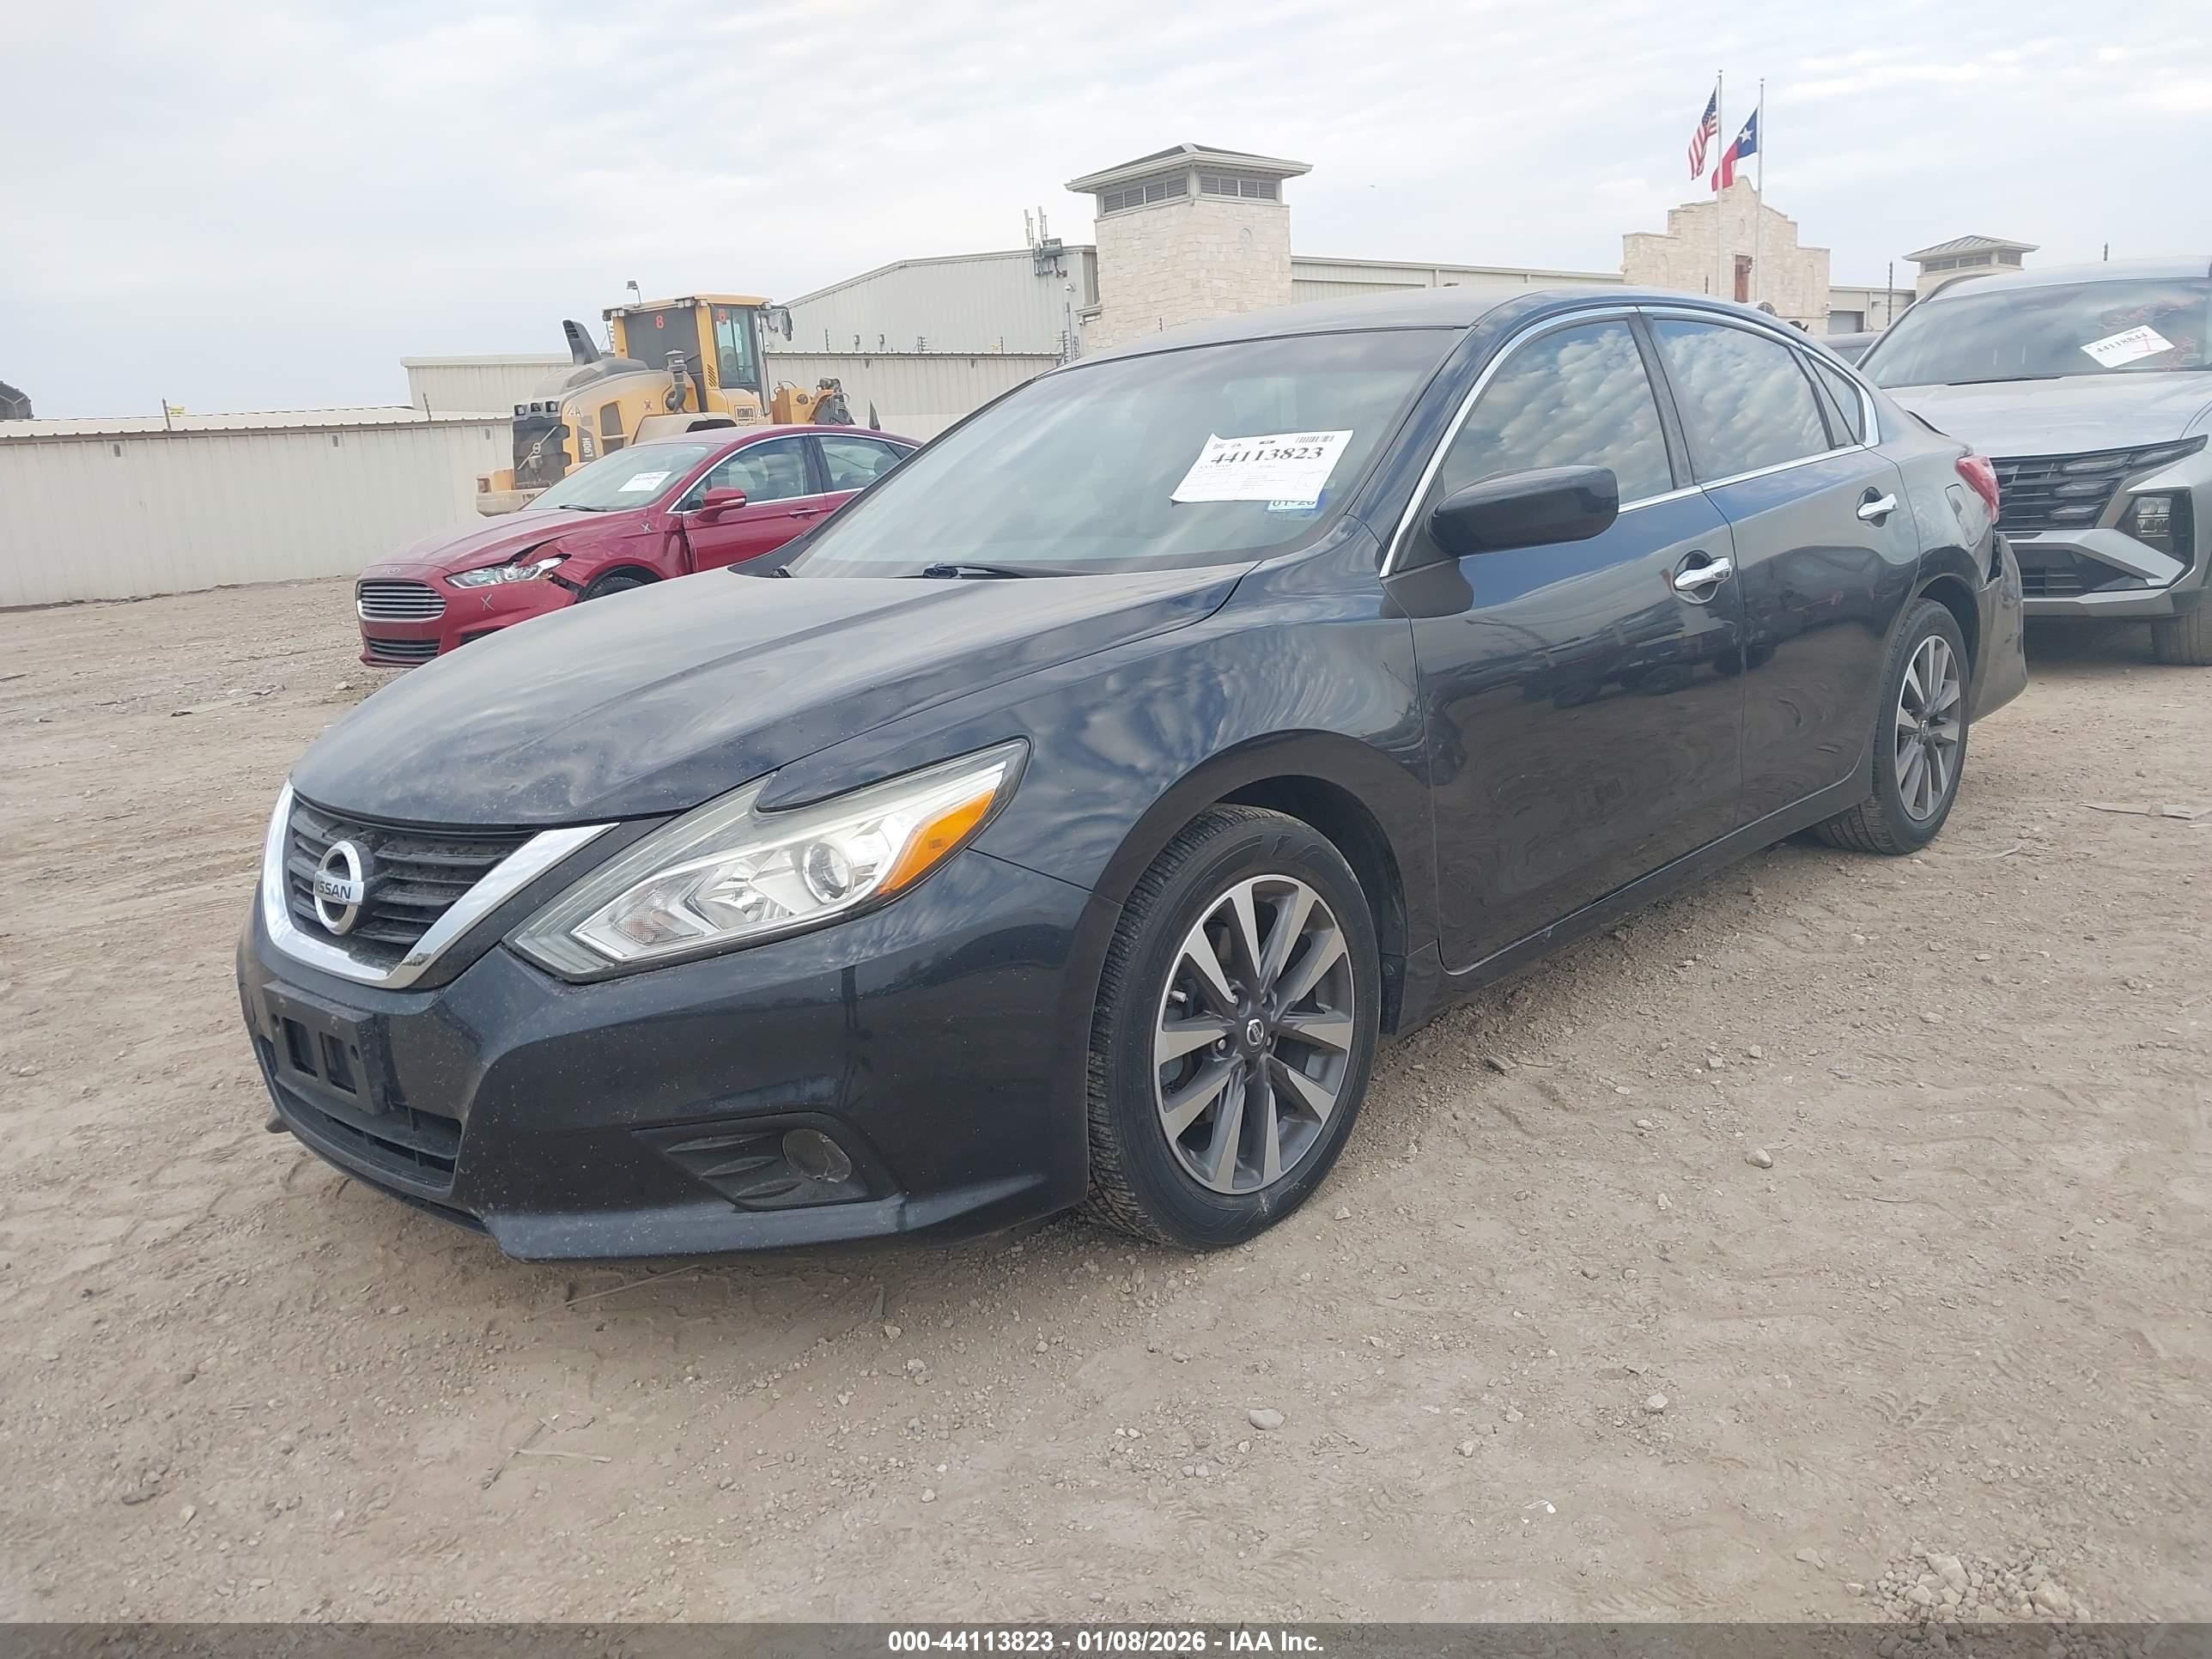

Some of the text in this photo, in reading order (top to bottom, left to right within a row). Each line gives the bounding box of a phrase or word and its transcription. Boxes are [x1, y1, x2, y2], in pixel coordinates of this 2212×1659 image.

[655, 315, 665, 329] 8
[582, 437, 593, 458] L90H
[1211, 447, 1324, 464] 44113823
